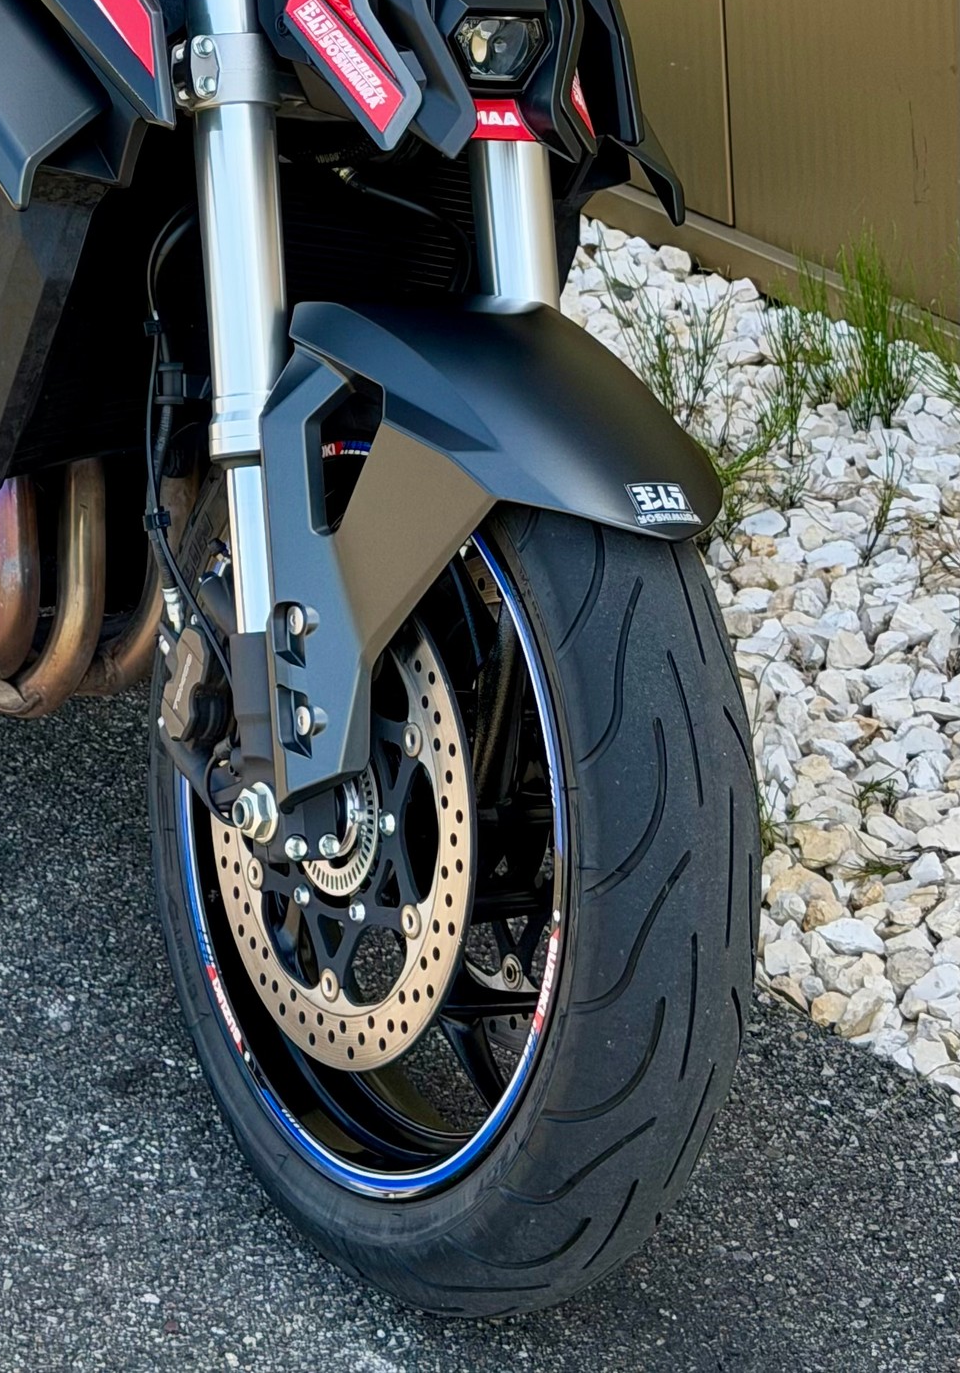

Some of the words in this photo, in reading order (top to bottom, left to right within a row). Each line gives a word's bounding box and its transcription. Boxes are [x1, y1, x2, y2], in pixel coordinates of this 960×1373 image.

[318, 35, 382, 110] YOSHIMURA
[330, 29, 382, 86] POWERED
[637, 512, 702, 524] YOSHIMURA
[537, 936, 558, 1017] SUZUKI
